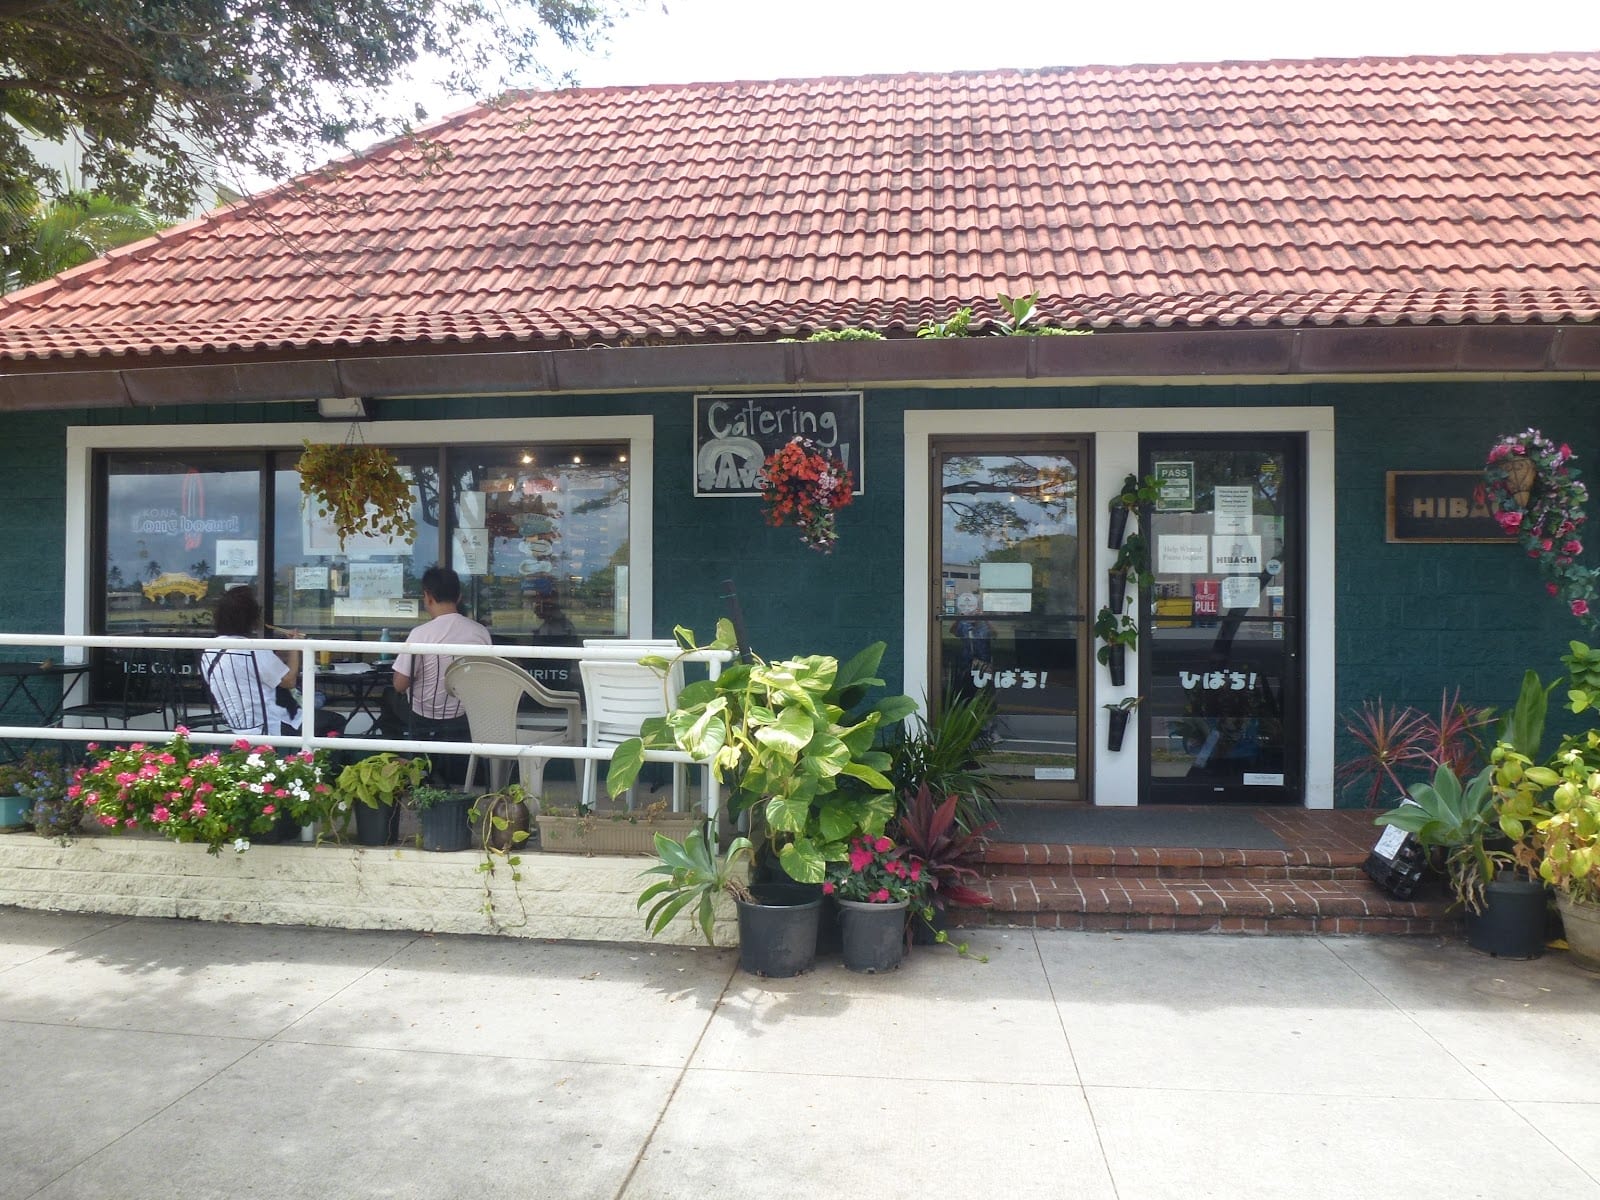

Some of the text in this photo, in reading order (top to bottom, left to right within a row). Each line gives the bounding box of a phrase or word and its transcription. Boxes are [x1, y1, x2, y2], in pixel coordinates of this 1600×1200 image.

[708, 400, 837, 448] Catering
[1161, 469, 1188, 477] PASS
[1413, 496, 1500, 519] HIBA
[1216, 556, 1257, 564] HIBACHI
[1195, 601, 1216, 613] PULL
[123, 661, 147, 674] ICE
[151, 662, 192, 675] CD
[970, 668, 1048, 689] ひばち!
[1179, 669, 1257, 690] ひばち!
